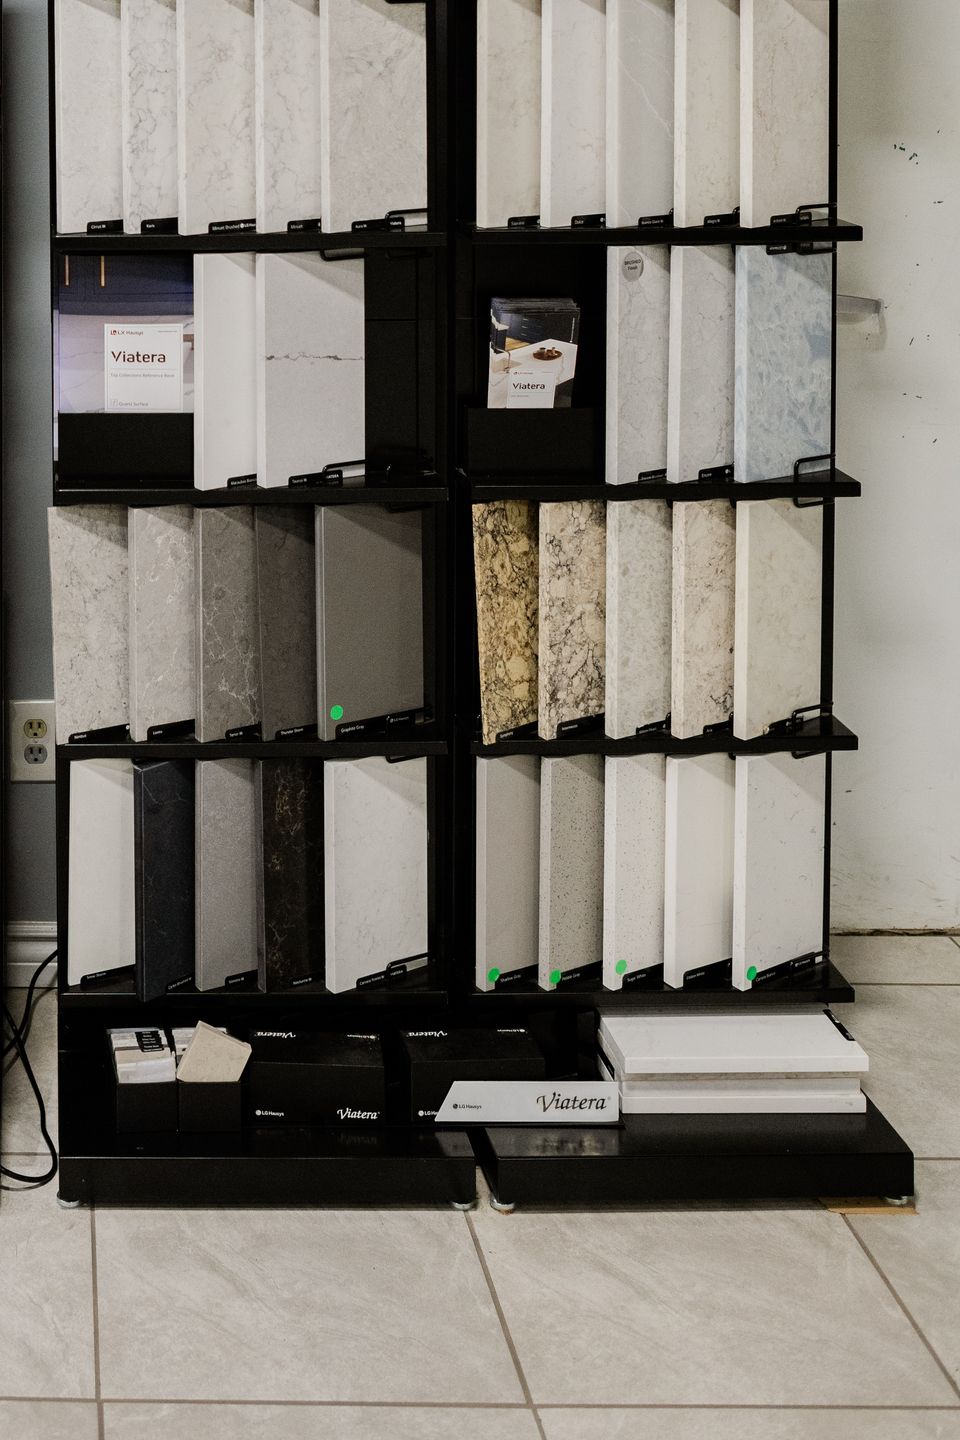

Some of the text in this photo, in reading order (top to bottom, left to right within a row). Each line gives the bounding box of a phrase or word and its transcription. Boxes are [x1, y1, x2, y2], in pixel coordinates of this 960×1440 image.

[111, 351, 166, 363] Viatera
[513, 382, 546, 390] Viatera
[536, 1092, 607, 1112] Viatera
[337, 1107, 378, 1120] Viatera
